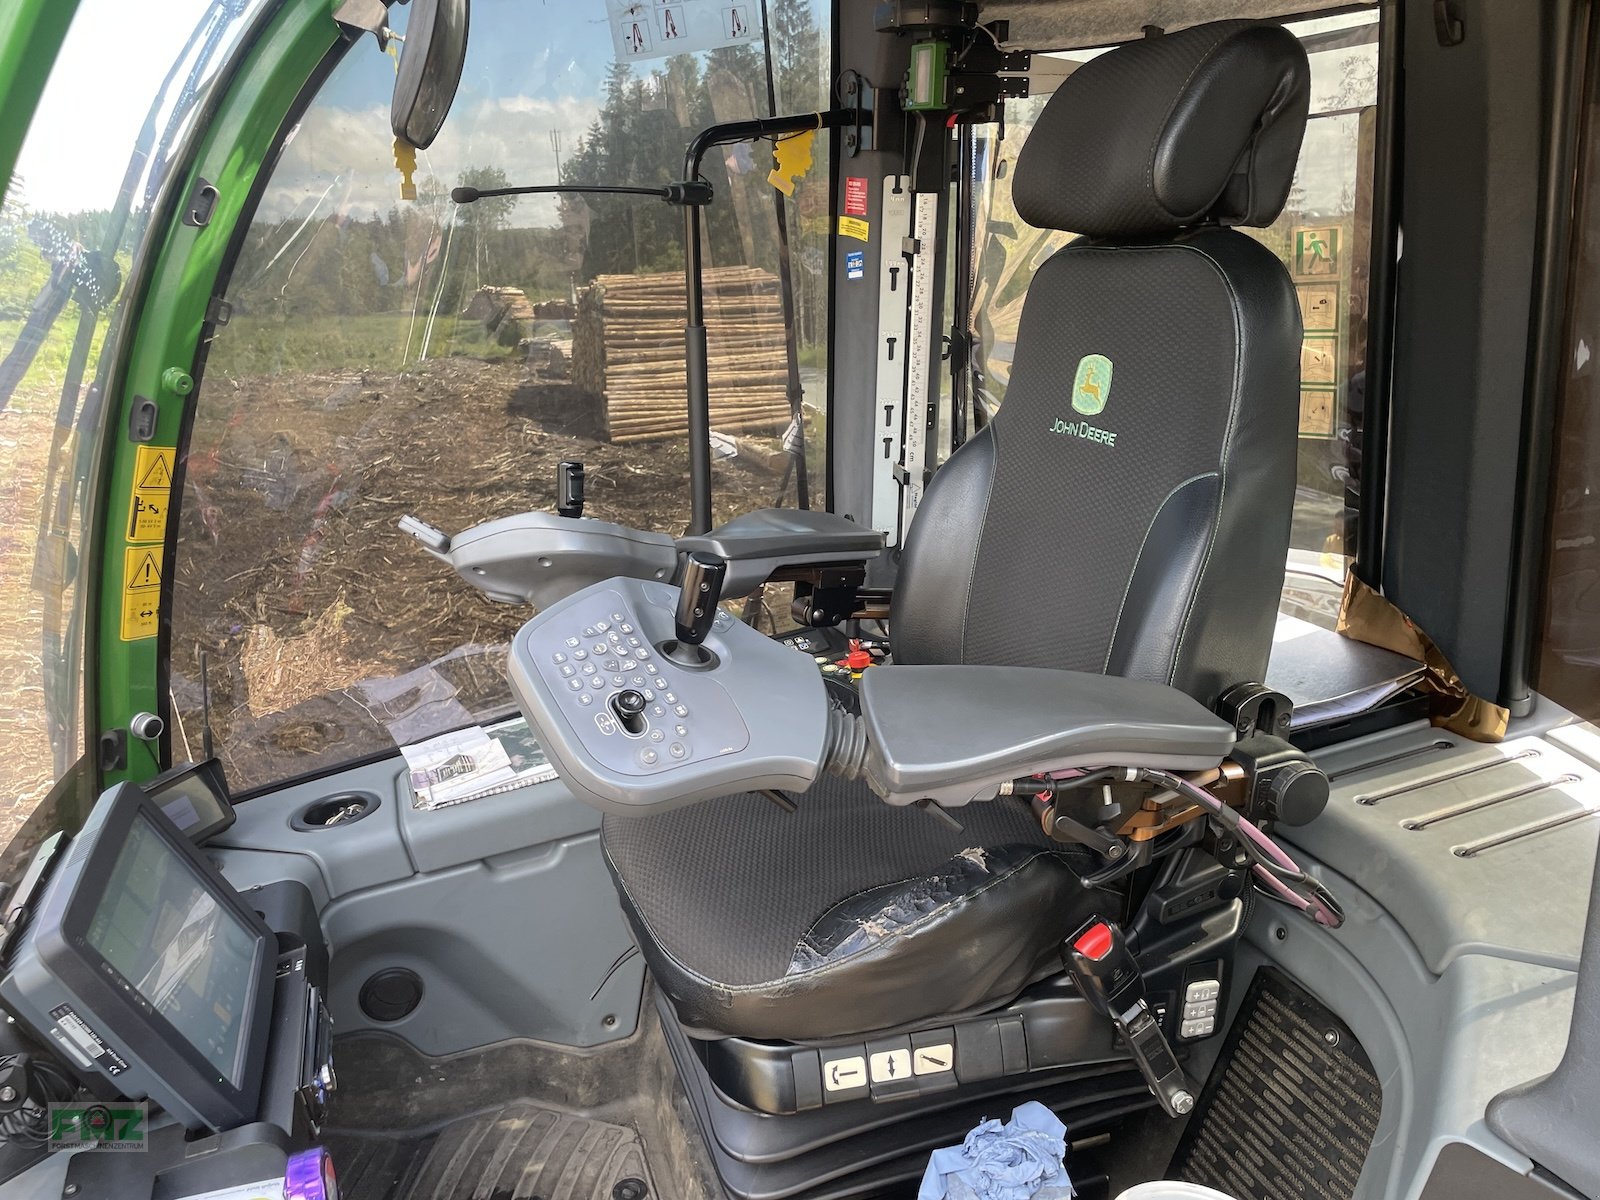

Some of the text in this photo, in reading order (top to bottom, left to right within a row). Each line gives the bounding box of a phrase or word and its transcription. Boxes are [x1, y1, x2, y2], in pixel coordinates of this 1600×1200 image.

[1050, 418, 1117, 447] JOHN DEERE
[909, 452, 915, 462] cm
